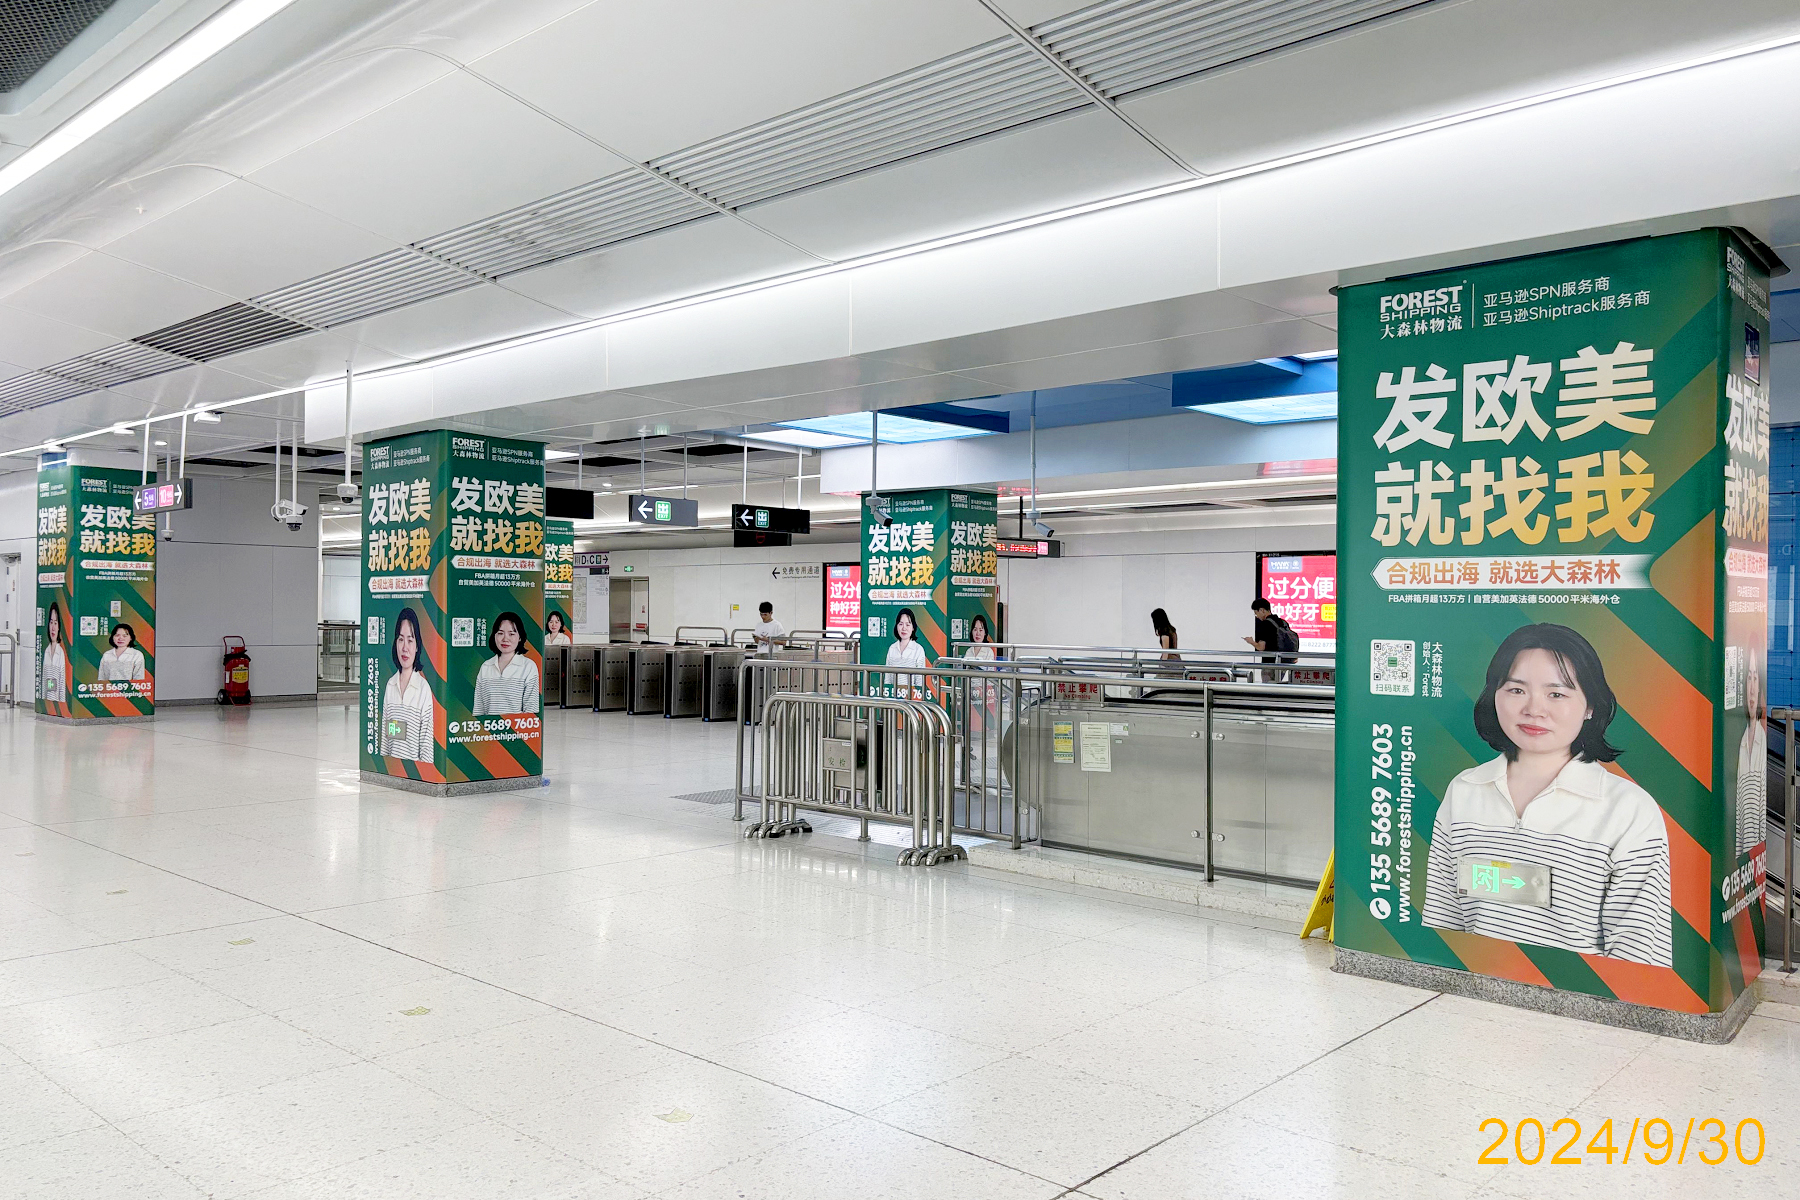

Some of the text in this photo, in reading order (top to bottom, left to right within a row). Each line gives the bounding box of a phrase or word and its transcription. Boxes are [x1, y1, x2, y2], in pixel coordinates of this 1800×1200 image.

[1380, 285, 1464, 314] FOREST
[1483, 276, 1611, 309] 亚马逊SPN服务商
[1380, 303, 1461, 322] SHIPPING
[1483, 290, 1650, 327] 亚马逊Shiptrack服务商
[1380, 315, 1463, 340] 大森林物流
[1372, 341, 1657, 454] 发欧美
[371, 446, 389, 457] FOREST
[452, 437, 485, 448] FOREST
[81, 478, 108, 487] FOREST
[368, 477, 431, 526] 发欧美
[450, 476, 544, 518] 发欧美
[657, 503, 669, 514] 出
[1370, 450, 1655, 547] 就找我
[38, 505, 67, 535] 发欧美
[757, 510, 767, 522] 出
[79, 529, 156, 557] 就找我
[450, 514, 543, 556] 就找我
[868, 521, 934, 553] 发欧美
[951, 521, 997, 548] 发欧美
[38, 536, 67, 566] 就找我
[368, 526, 431, 572] 就找我
[950, 548, 997, 575] 就找我
[457, 557, 536, 570] 合规出海 就选大森林
[868, 555, 934, 586] 就找我
[1386, 559, 1621, 585] 合规出海 就选大森林
[1267, 576, 1336, 599] 过分便
[1388, 594, 1465, 604] FBA拼箱月超13万方
[1431, 641, 1443, 698] 大森林物流
[77, 691, 151, 699] www.forestshipping.cn
[88, 682, 152, 692] 135 5689 7603
[912, 689, 932, 700] 763
[1057, 682, 1098, 694] 禁止攀爬
[1375, 683, 1410, 693] 扫码联系
[448, 730, 539, 744] www.forestshipping.cn
[461, 717, 540, 733] 135 5689 7603
[1370, 723, 1393, 893] 135 5689 7603
[1396, 725, 1416, 923] www.forestshipping.cn
